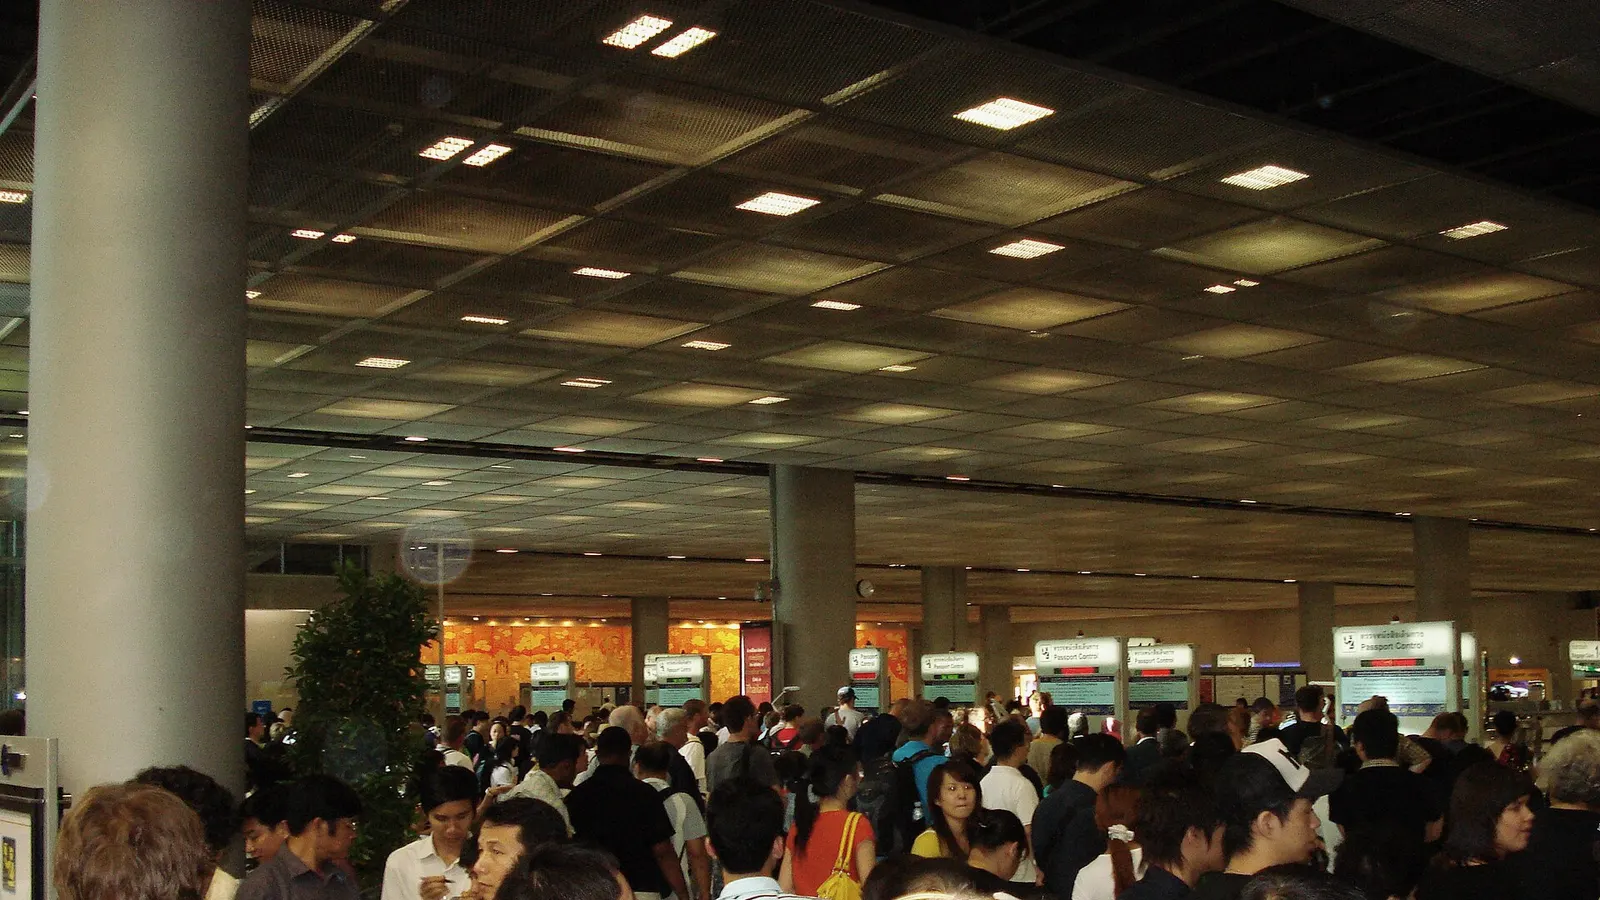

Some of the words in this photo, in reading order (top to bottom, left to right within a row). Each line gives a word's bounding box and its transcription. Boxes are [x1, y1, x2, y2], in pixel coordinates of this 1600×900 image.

[1360, 643, 1394, 651] Passport
[1395, 642, 1424, 650] Control
[1243, 657, 1253, 667] 15
